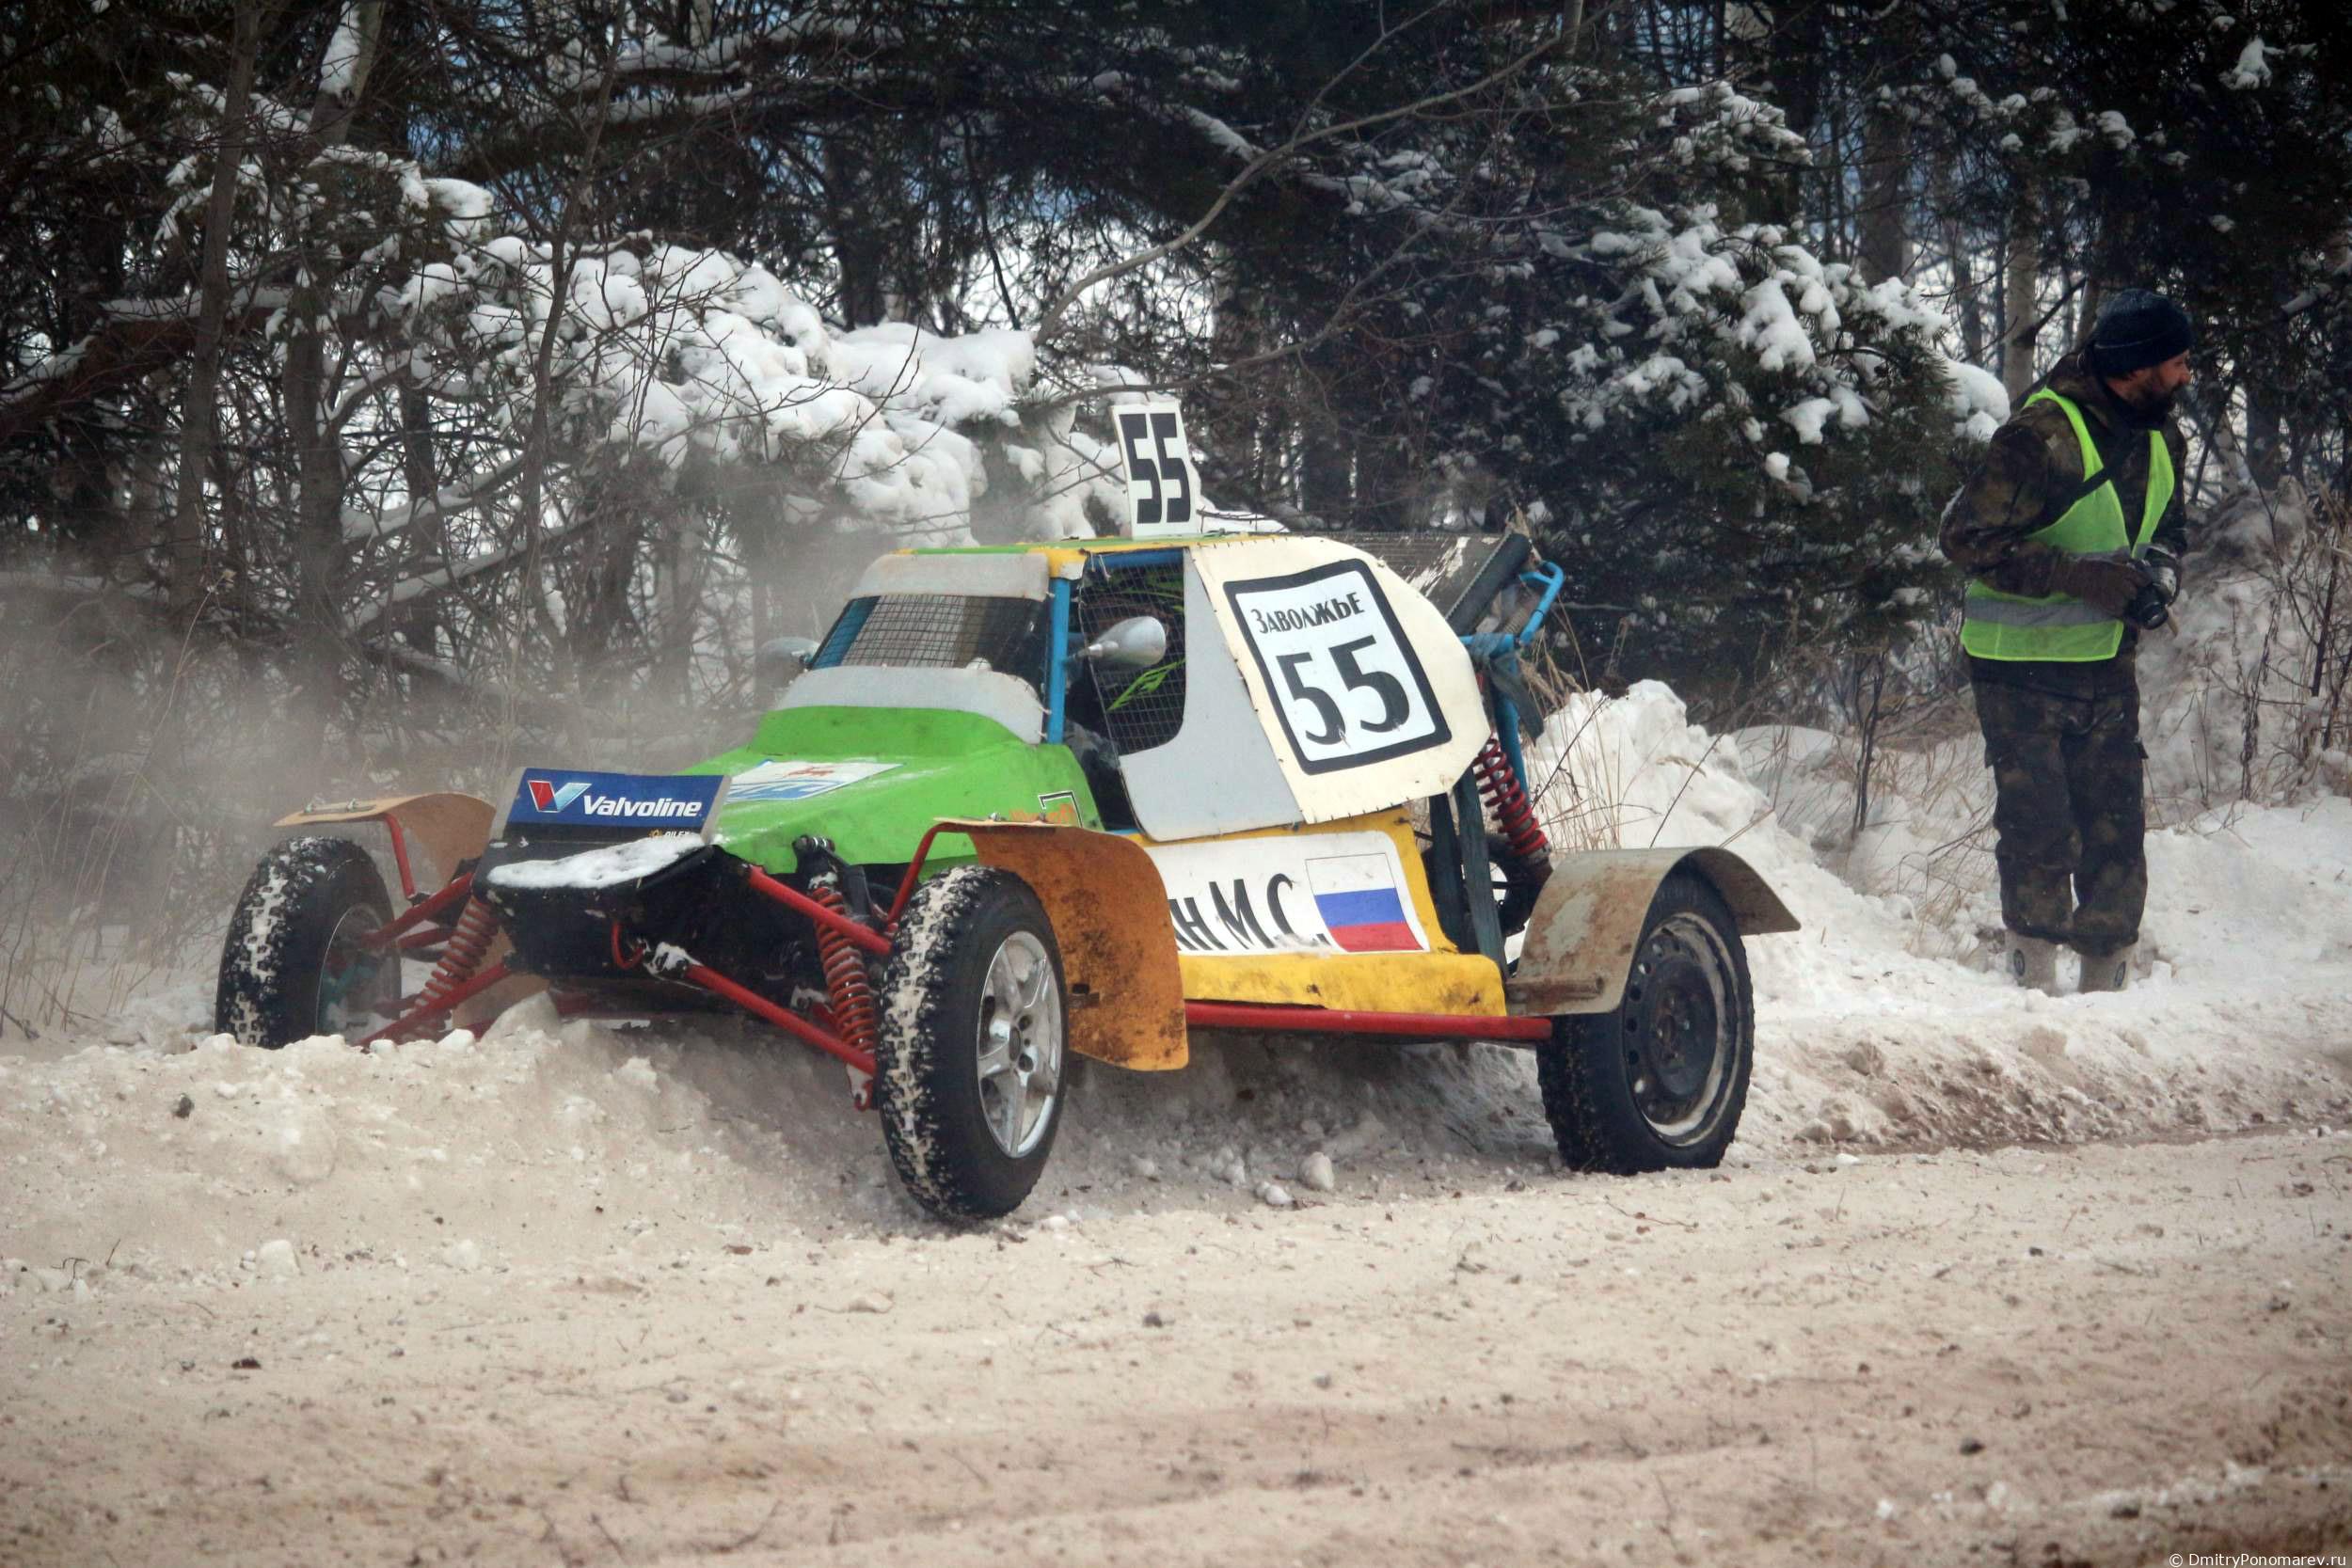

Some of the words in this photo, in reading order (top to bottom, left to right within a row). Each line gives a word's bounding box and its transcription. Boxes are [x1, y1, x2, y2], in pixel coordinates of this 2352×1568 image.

[1120, 413, 1191, 524] 55
[1276, 635, 1410, 746] 55
[583, 795, 703, 816] Valvoline
